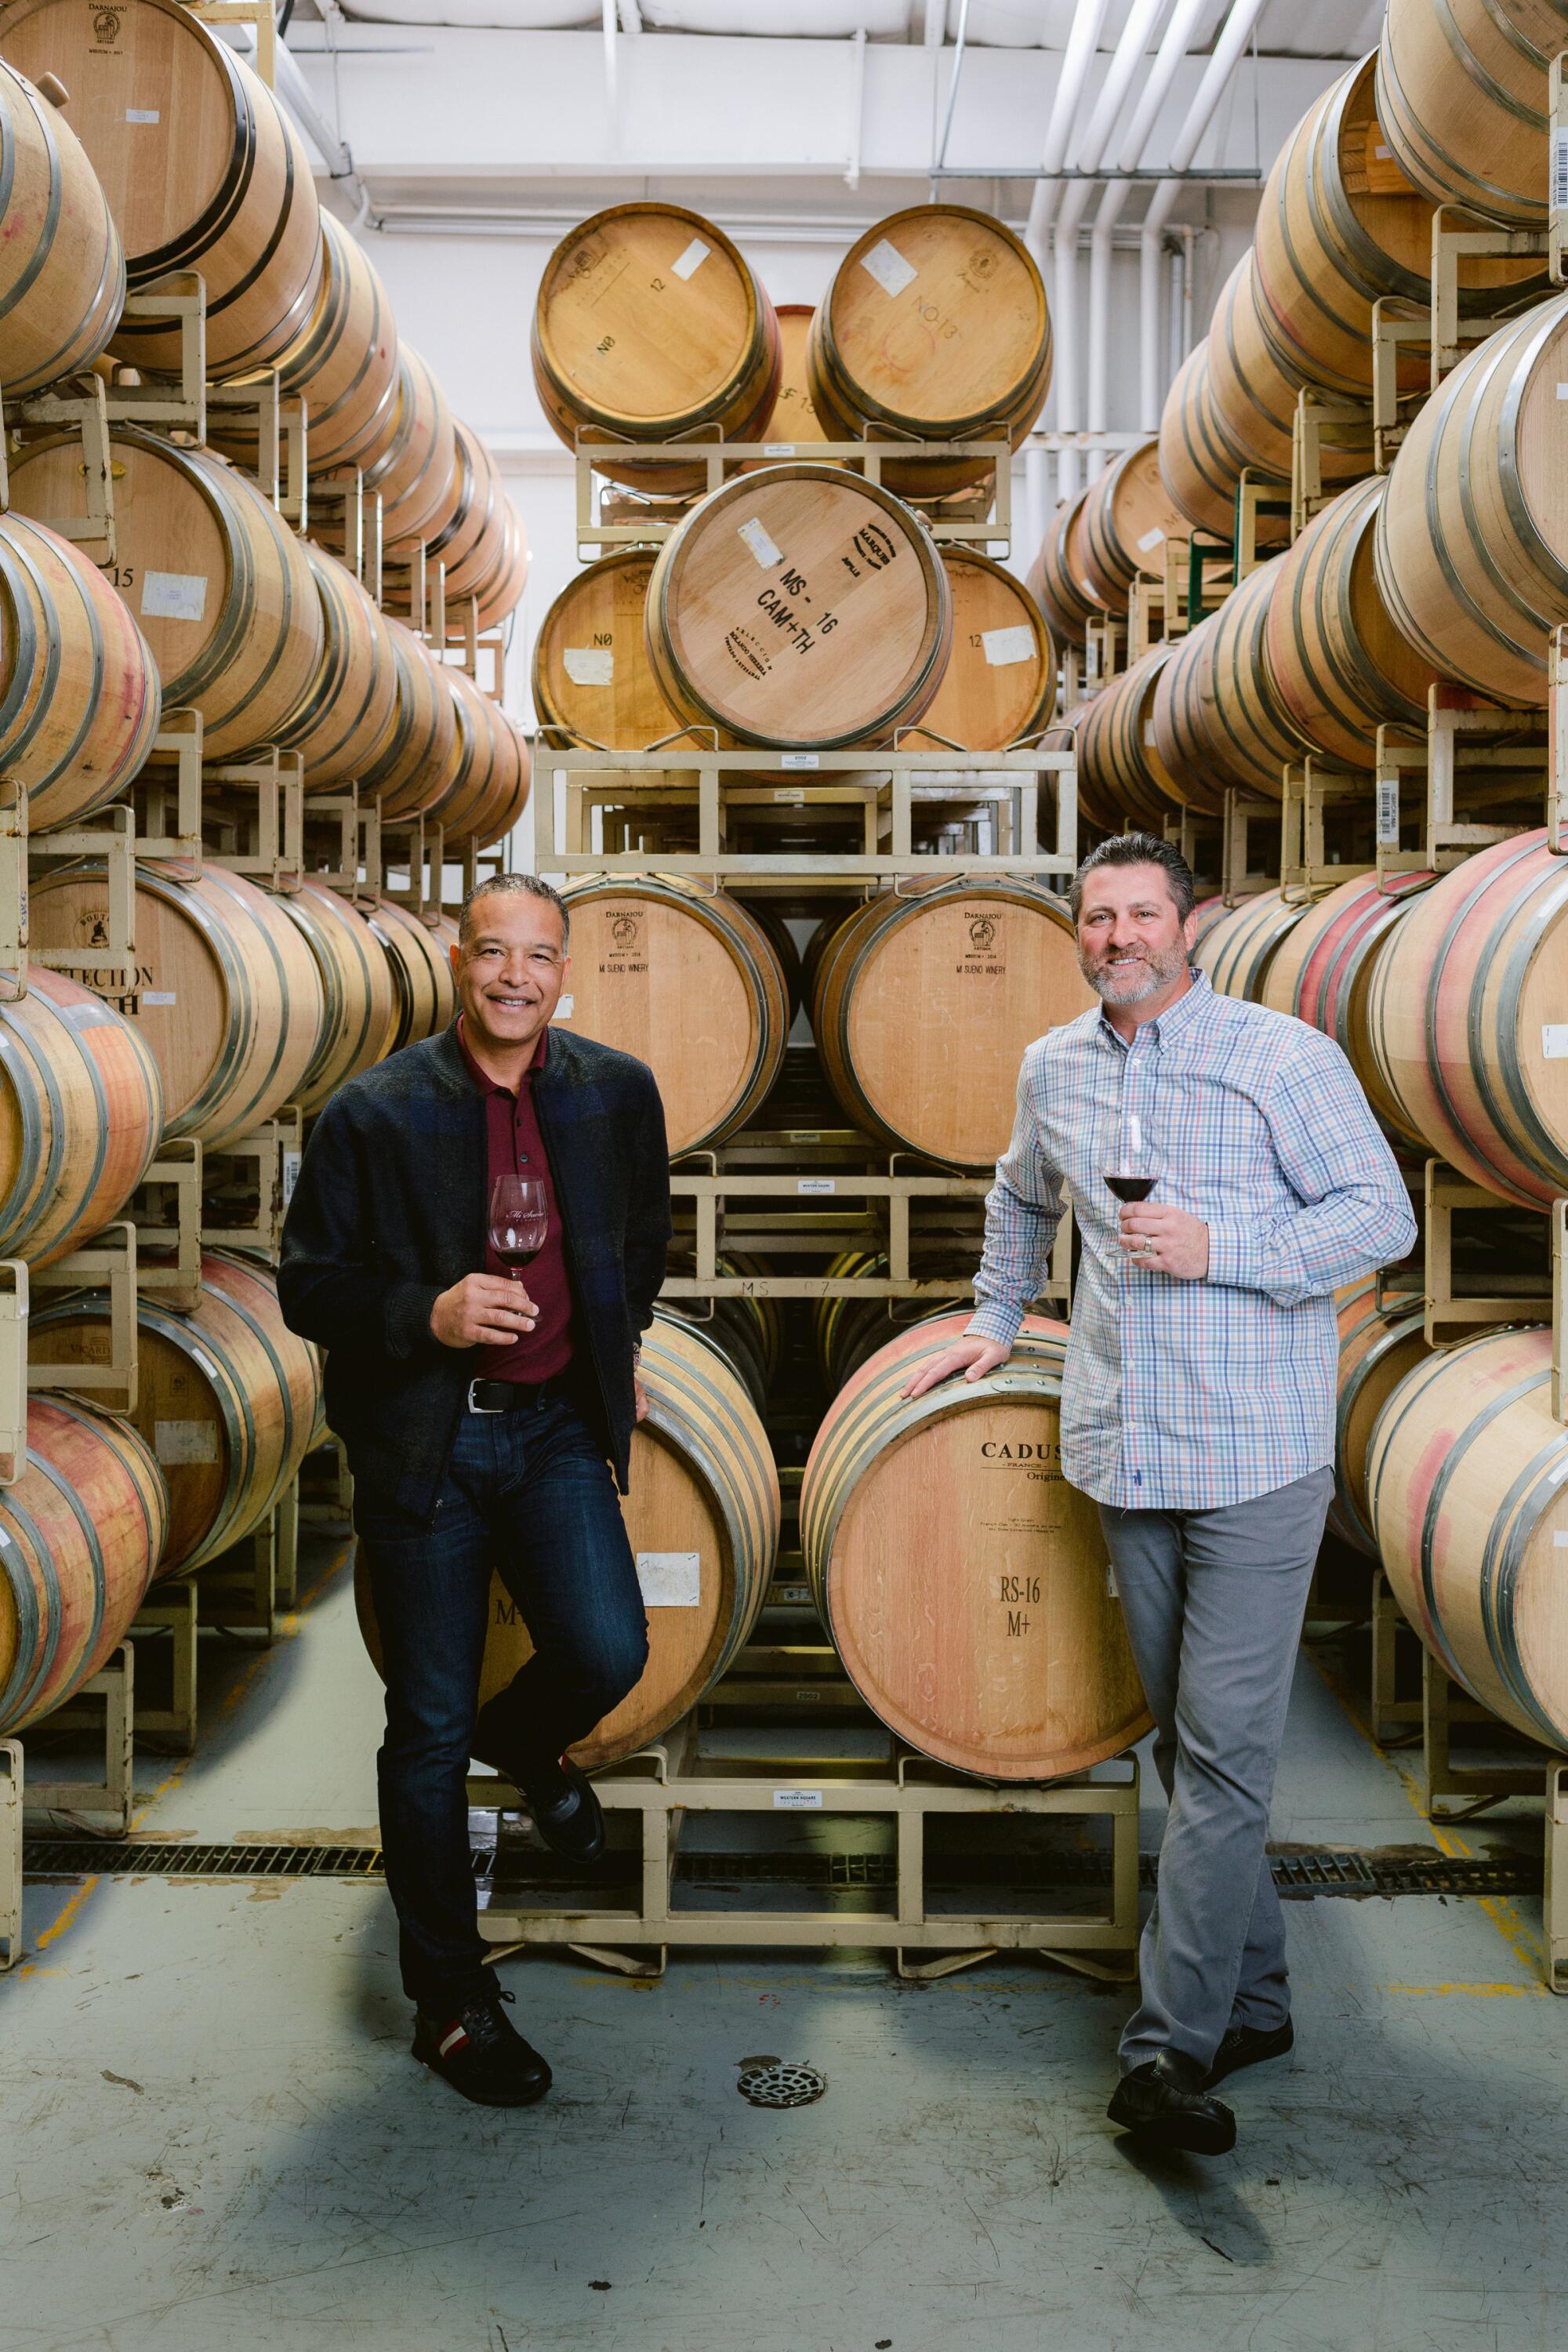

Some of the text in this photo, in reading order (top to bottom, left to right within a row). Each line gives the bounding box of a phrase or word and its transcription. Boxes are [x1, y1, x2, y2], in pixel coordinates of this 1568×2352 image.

[89, 3, 127, 12] DARNAJOU
[650, 278, 666, 292] 12
[859, 528, 891, 565] MARQUES
[816, 612, 839, 634] 16
[729, 631, 750, 655] ROLANDO
[969, 633, 982, 648] 12
[80, 912, 110, 927] BOUT
[629, 964, 649, 972] WINERY
[985, 966, 1007, 975] WINERY
[70, 1344, 111, 1356] VICARD
[1000, 1576, 1040, 1603] RS-16
[1007, 1610, 1031, 1637] M+
